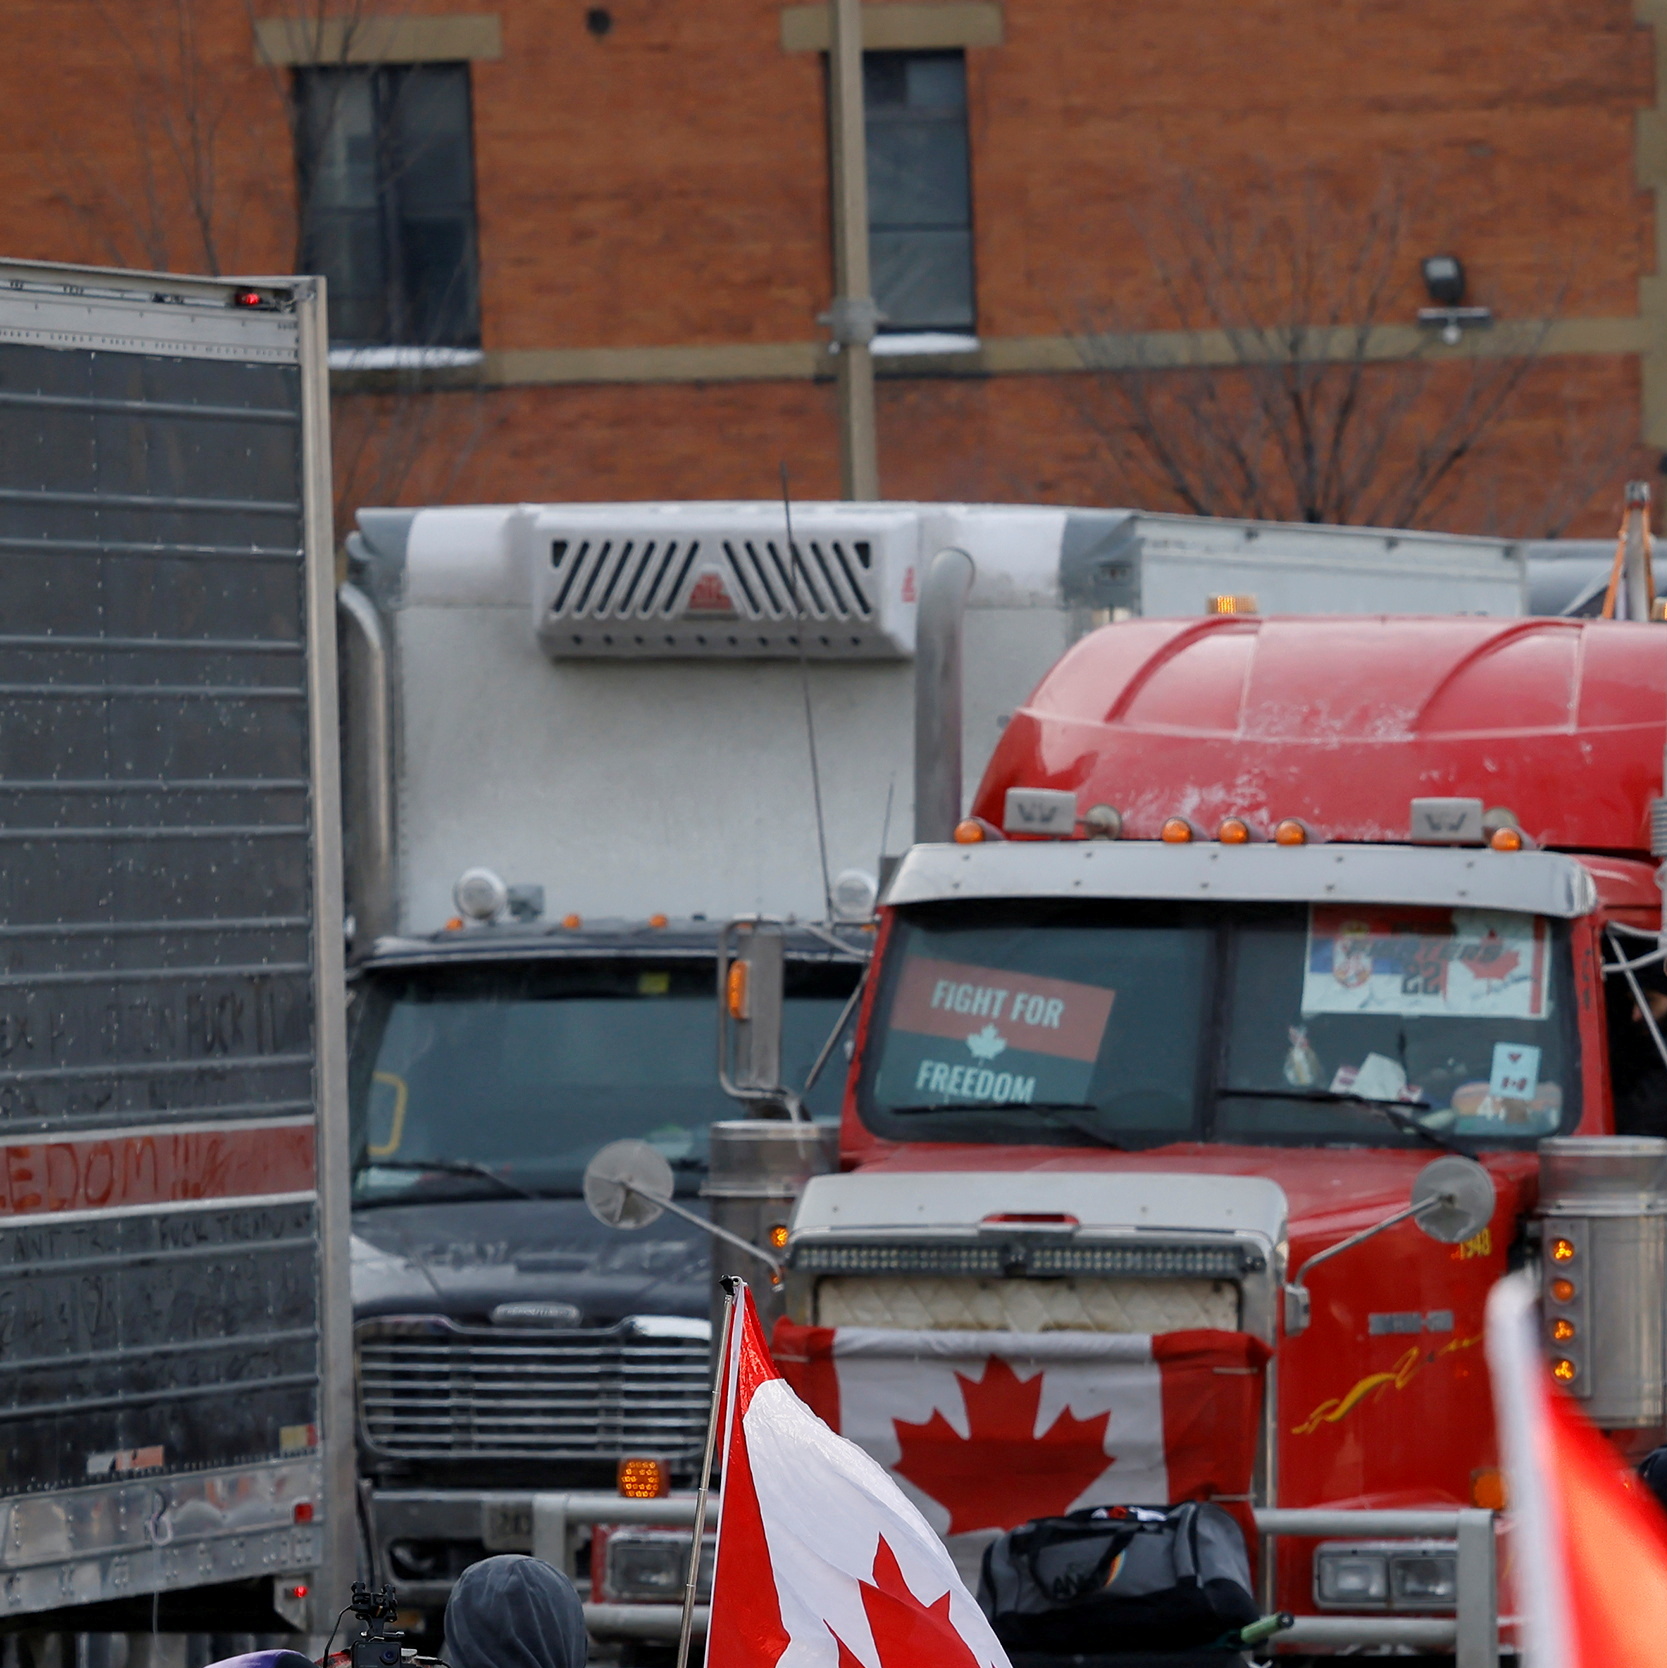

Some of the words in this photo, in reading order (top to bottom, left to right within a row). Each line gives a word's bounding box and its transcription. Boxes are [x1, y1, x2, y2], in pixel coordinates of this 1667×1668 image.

[931, 978, 1010, 1019] FIGHT
[1010, 991, 1066, 1029] FOR
[915, 1059, 1038, 1104] FREEDOM
[0, 1134, 202, 1214] EDOM!!!
